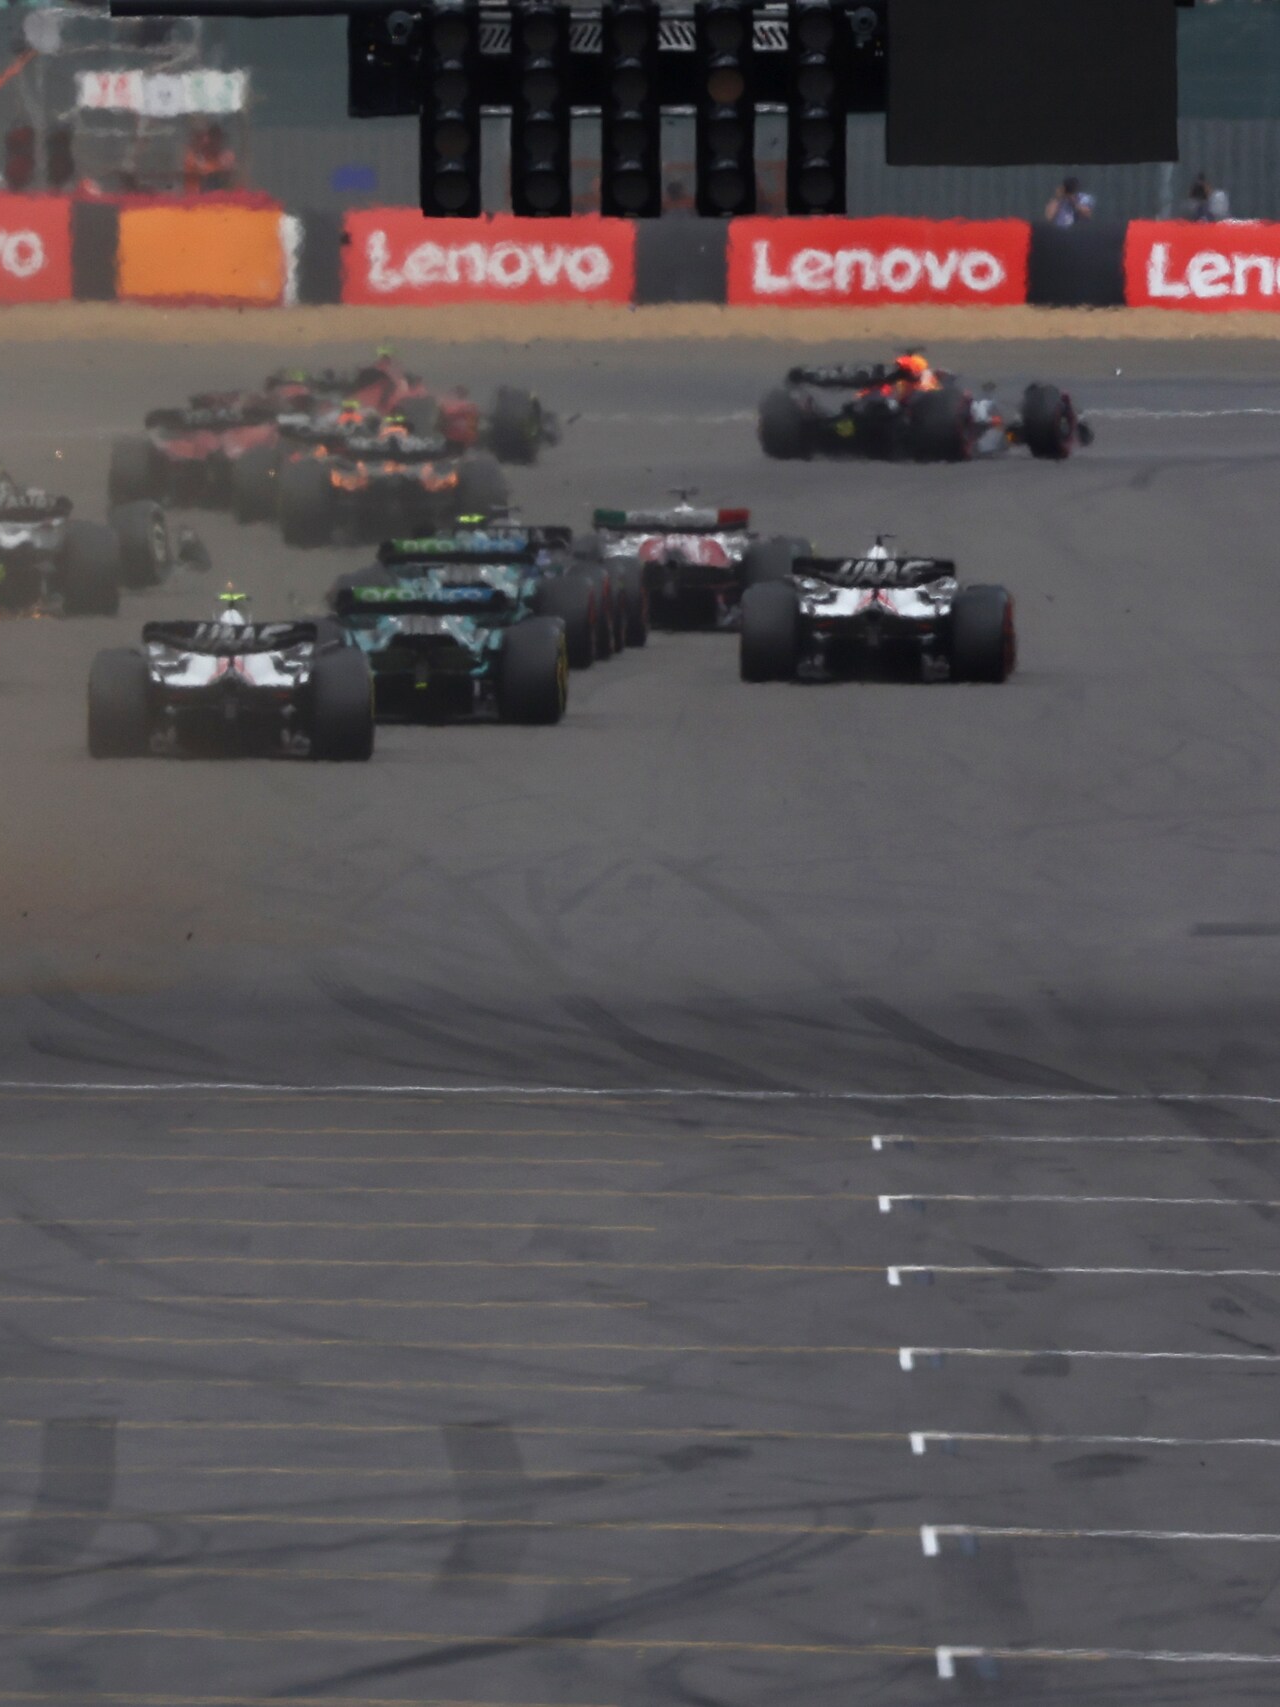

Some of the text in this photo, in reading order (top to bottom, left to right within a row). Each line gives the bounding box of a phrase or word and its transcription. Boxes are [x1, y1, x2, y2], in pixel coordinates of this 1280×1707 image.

[367, 230, 612, 292] Lenovo
[753, 240, 1005, 293] Lenovo
[1147, 243, 1280, 299] Len
